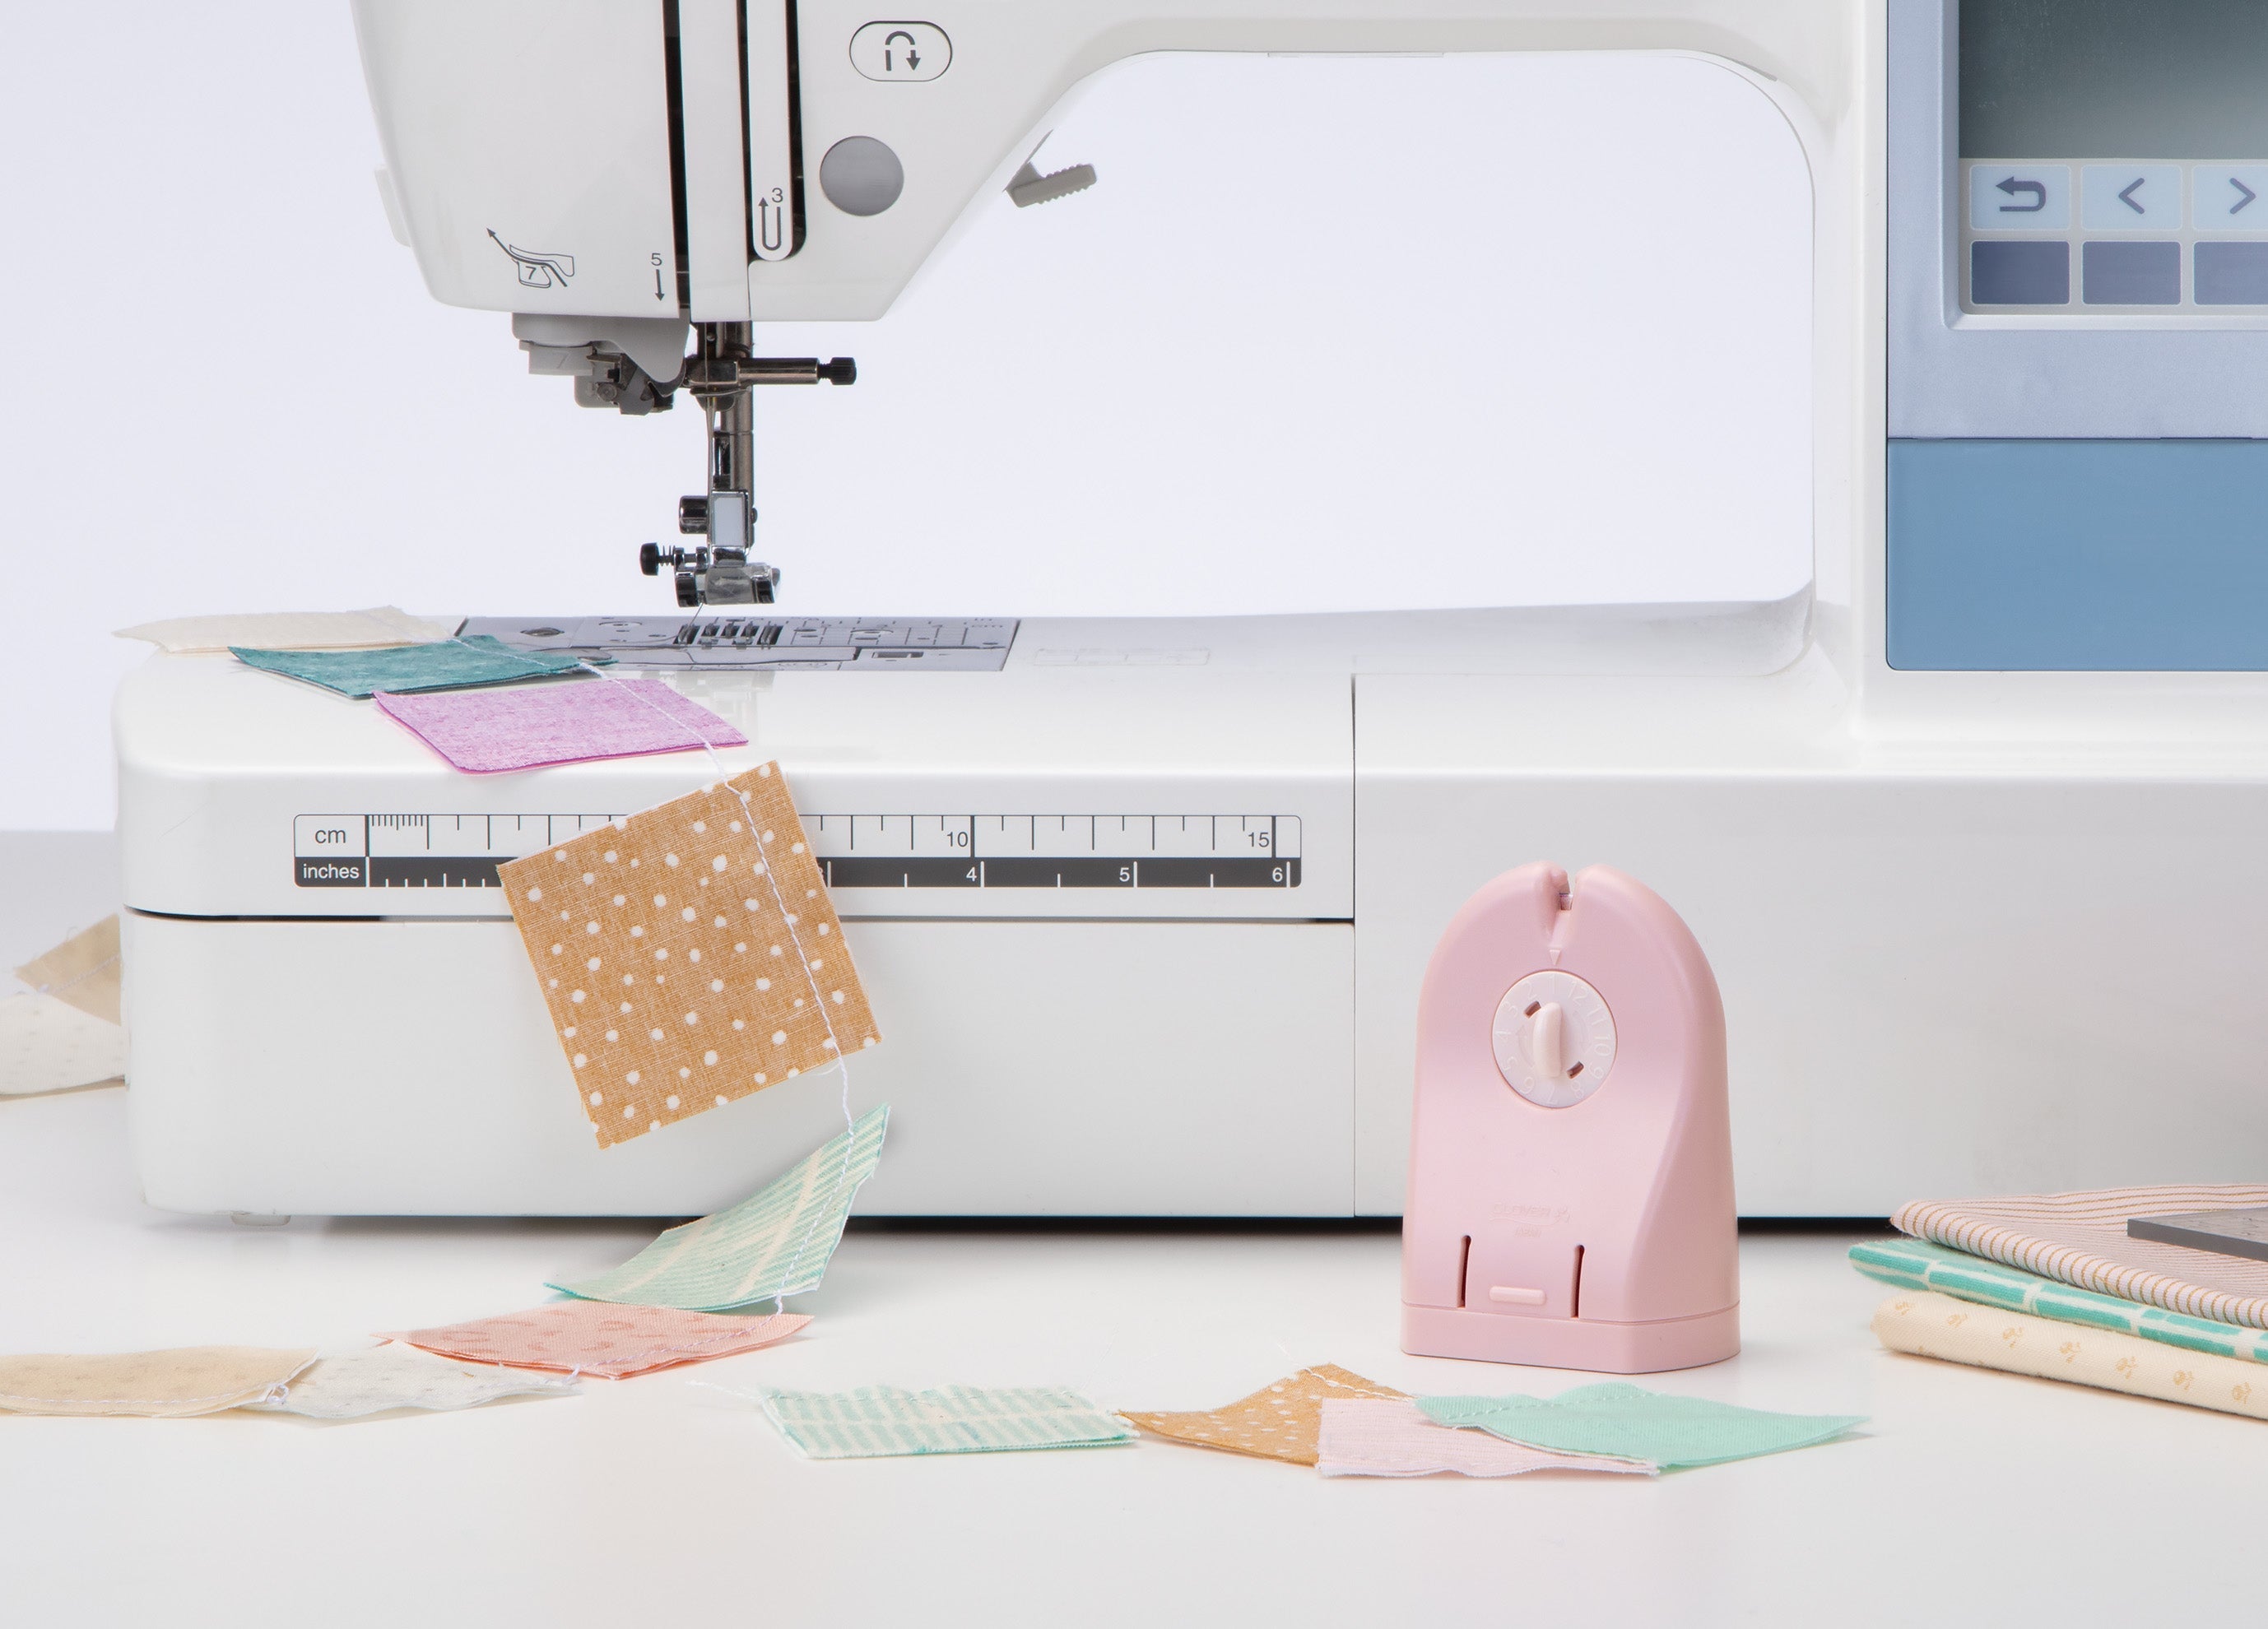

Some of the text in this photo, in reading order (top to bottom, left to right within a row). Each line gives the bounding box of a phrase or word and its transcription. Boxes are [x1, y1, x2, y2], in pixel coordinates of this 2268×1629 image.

[771, 188, 783, 203] 3
[652, 253, 662, 266] 5
[525, 266, 537, 280] 7
[315, 830, 1269, 847] cm 10 15
[304, 864, 1282, 882] inches 4 5 6
[1568, 981, 1588, 1005] 12
[1587, 1004, 1607, 1025] 11
[1594, 1034, 1611, 1056] 10
[1588, 1062, 1604, 1079] 9
[1570, 1080, 1584, 1099] 8
